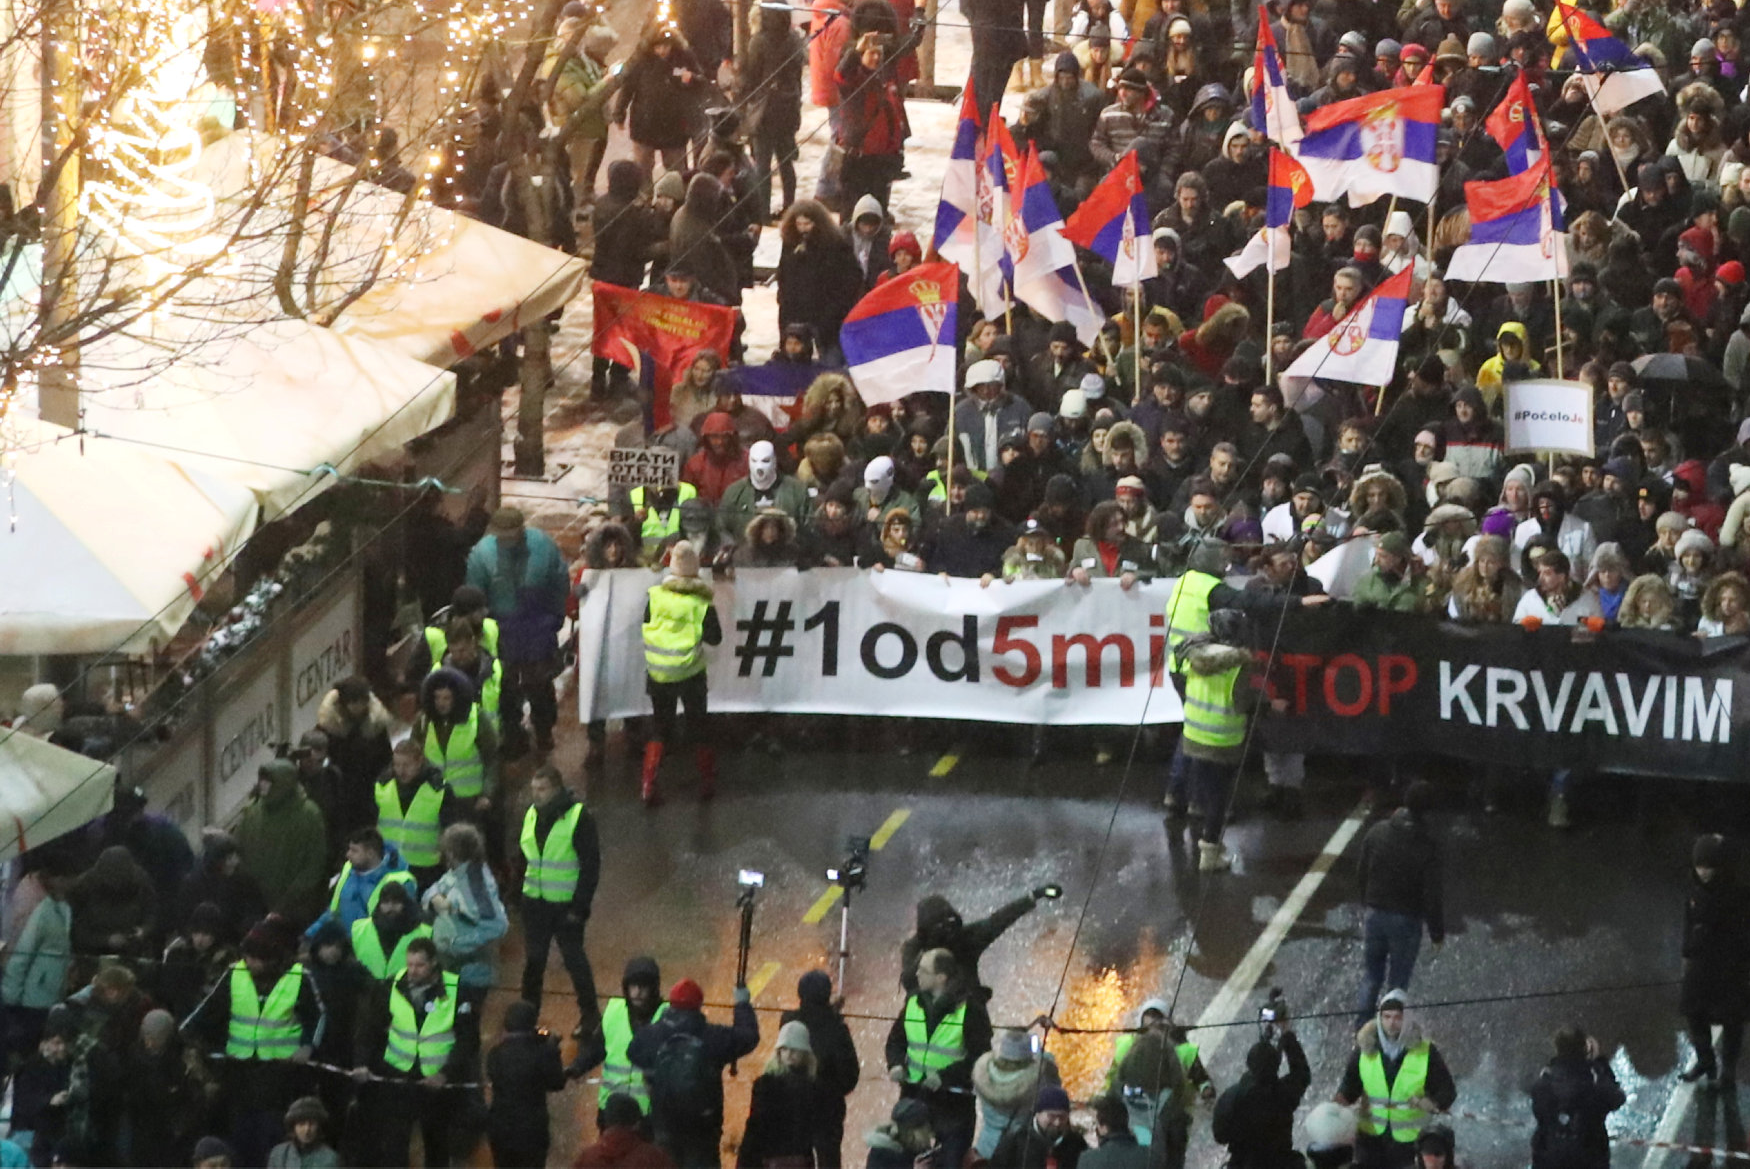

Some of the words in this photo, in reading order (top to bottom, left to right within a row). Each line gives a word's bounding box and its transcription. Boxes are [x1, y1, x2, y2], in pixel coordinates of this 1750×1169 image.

[609, 450, 675, 465] ВРАТИ
[611, 464, 674, 477] ОТЕТЕ
[296, 628, 352, 709] CENTAR
[1438, 660, 1733, 745] KRVAVIM
